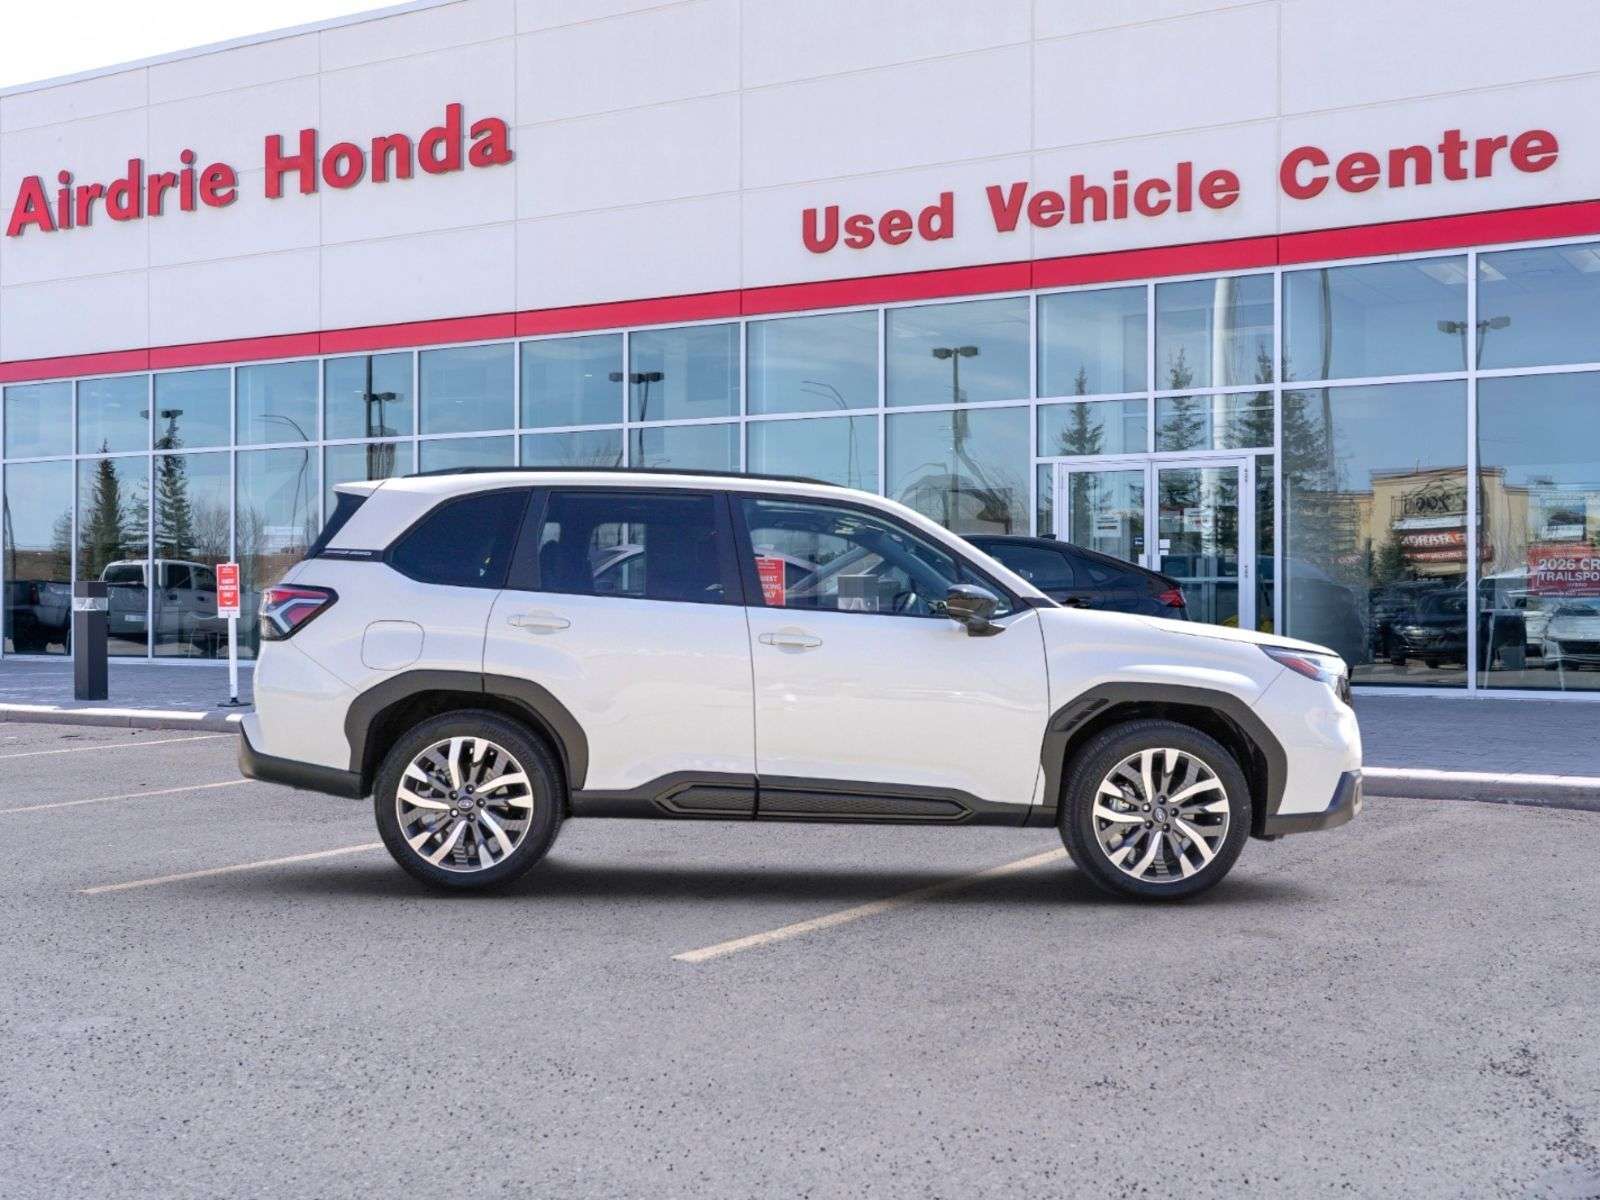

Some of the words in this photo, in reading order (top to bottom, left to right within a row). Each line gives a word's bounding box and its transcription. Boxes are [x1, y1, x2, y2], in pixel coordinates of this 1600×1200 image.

[7, 149, 236, 236] Airdrie
[265, 103, 513, 198] Honda
[802, 191, 954, 253] Used
[986, 161, 1240, 232] Vehicle
[1279, 129, 1559, 200] Centre
[1539, 559, 1575, 570] 2026
